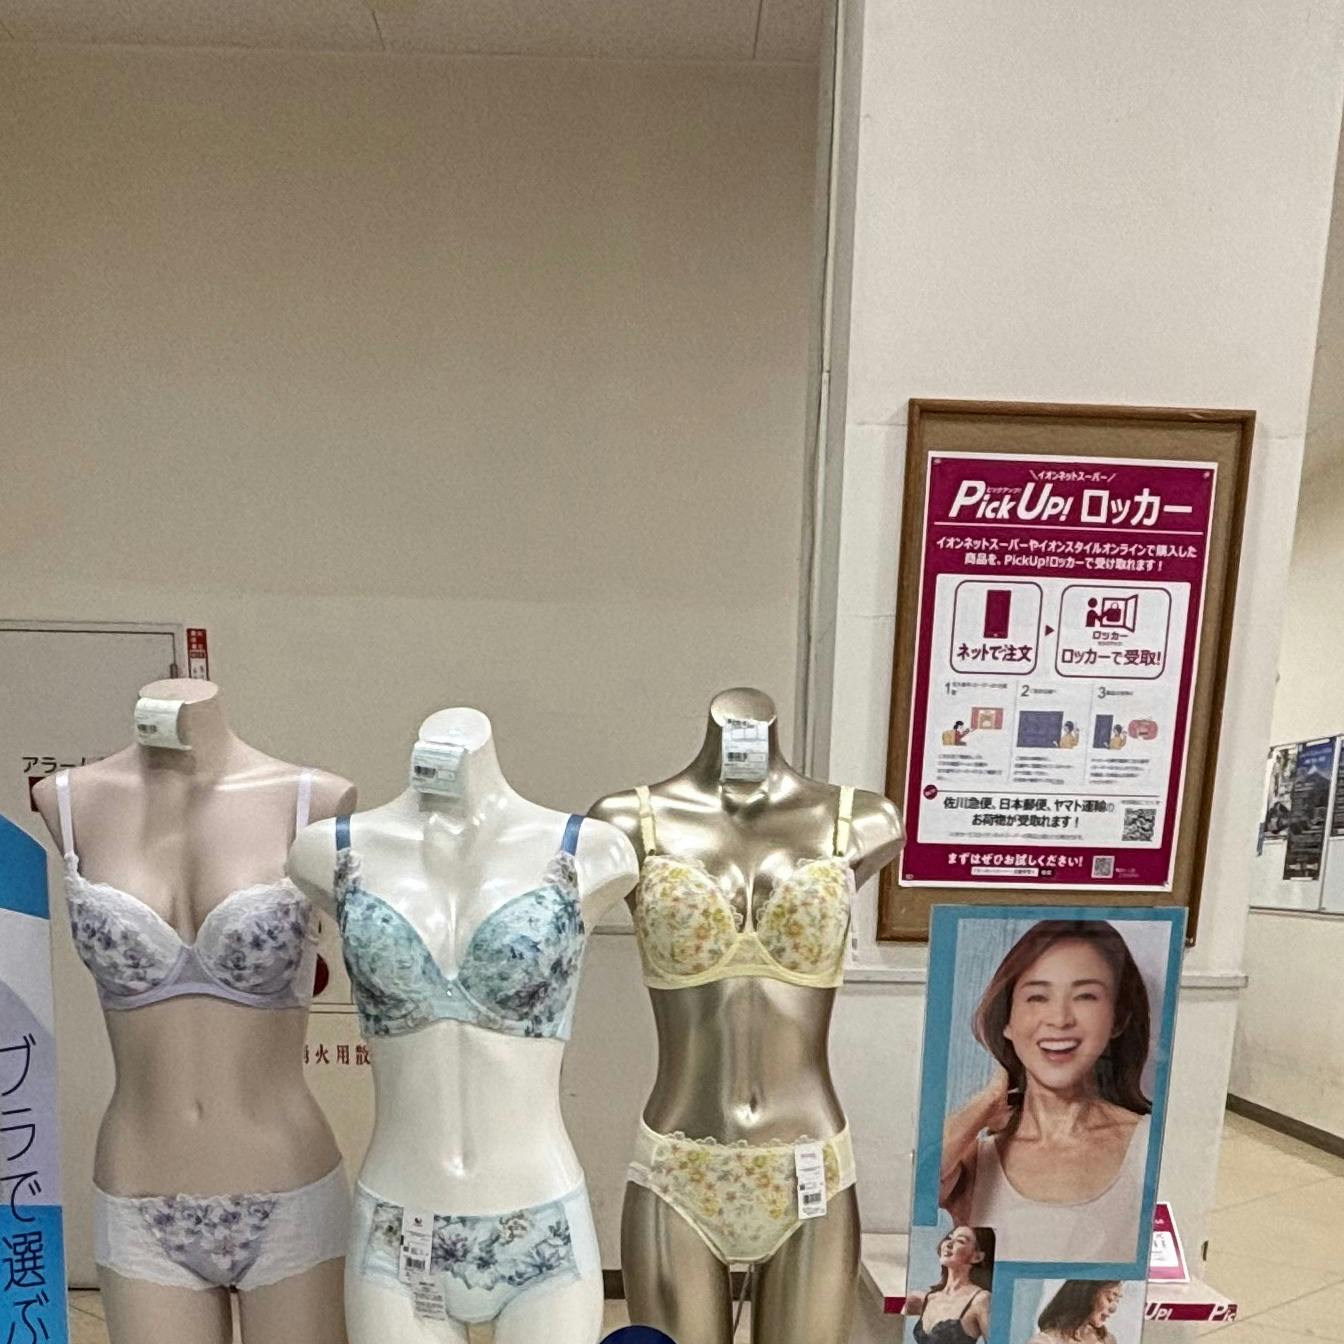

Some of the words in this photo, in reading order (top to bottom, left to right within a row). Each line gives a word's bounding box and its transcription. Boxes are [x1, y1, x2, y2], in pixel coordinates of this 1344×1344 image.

[1080, 487, 1193, 527] ロッカー
[957, 643, 1034, 663] ネットで注文
[1061, 648, 1163, 667] ロッカーで受取!
[304, 1043, 371, 1066] 火用散
